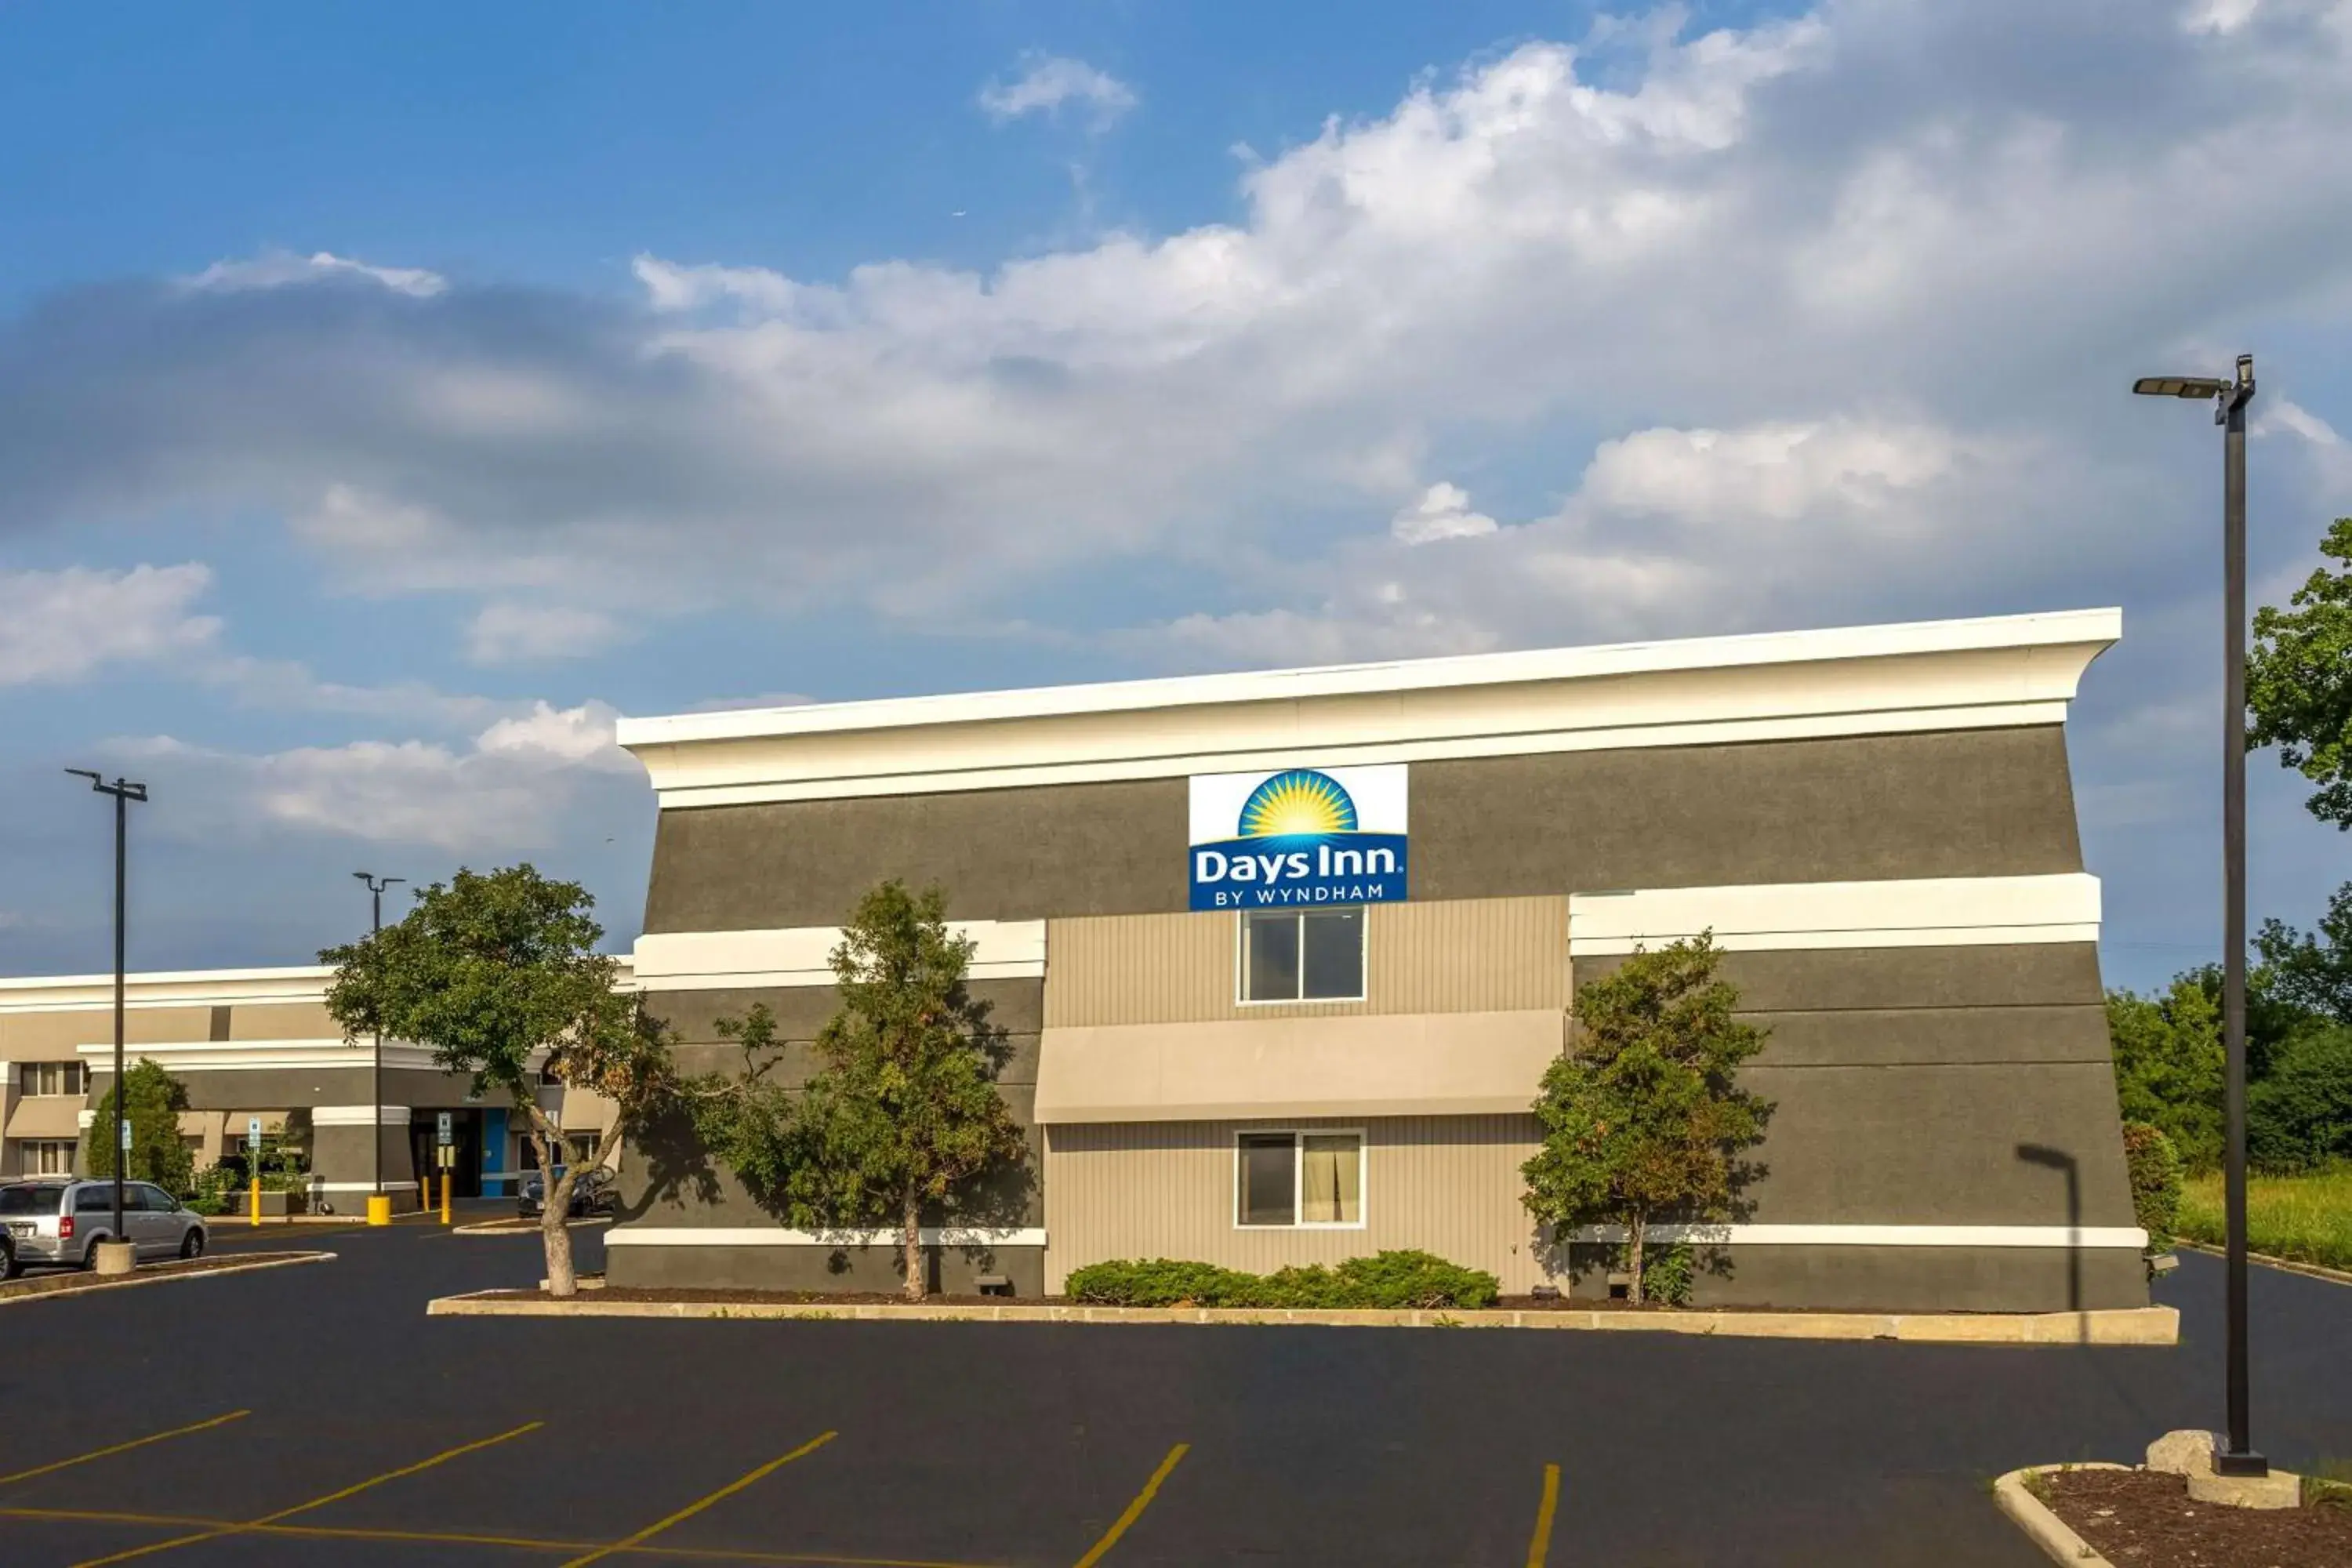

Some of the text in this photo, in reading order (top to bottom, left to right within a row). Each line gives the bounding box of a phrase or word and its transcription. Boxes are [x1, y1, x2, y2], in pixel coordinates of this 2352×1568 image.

[1196, 844, 1395, 884] Days Inn
[1215, 884, 1383, 906] BY WYNDHAM
